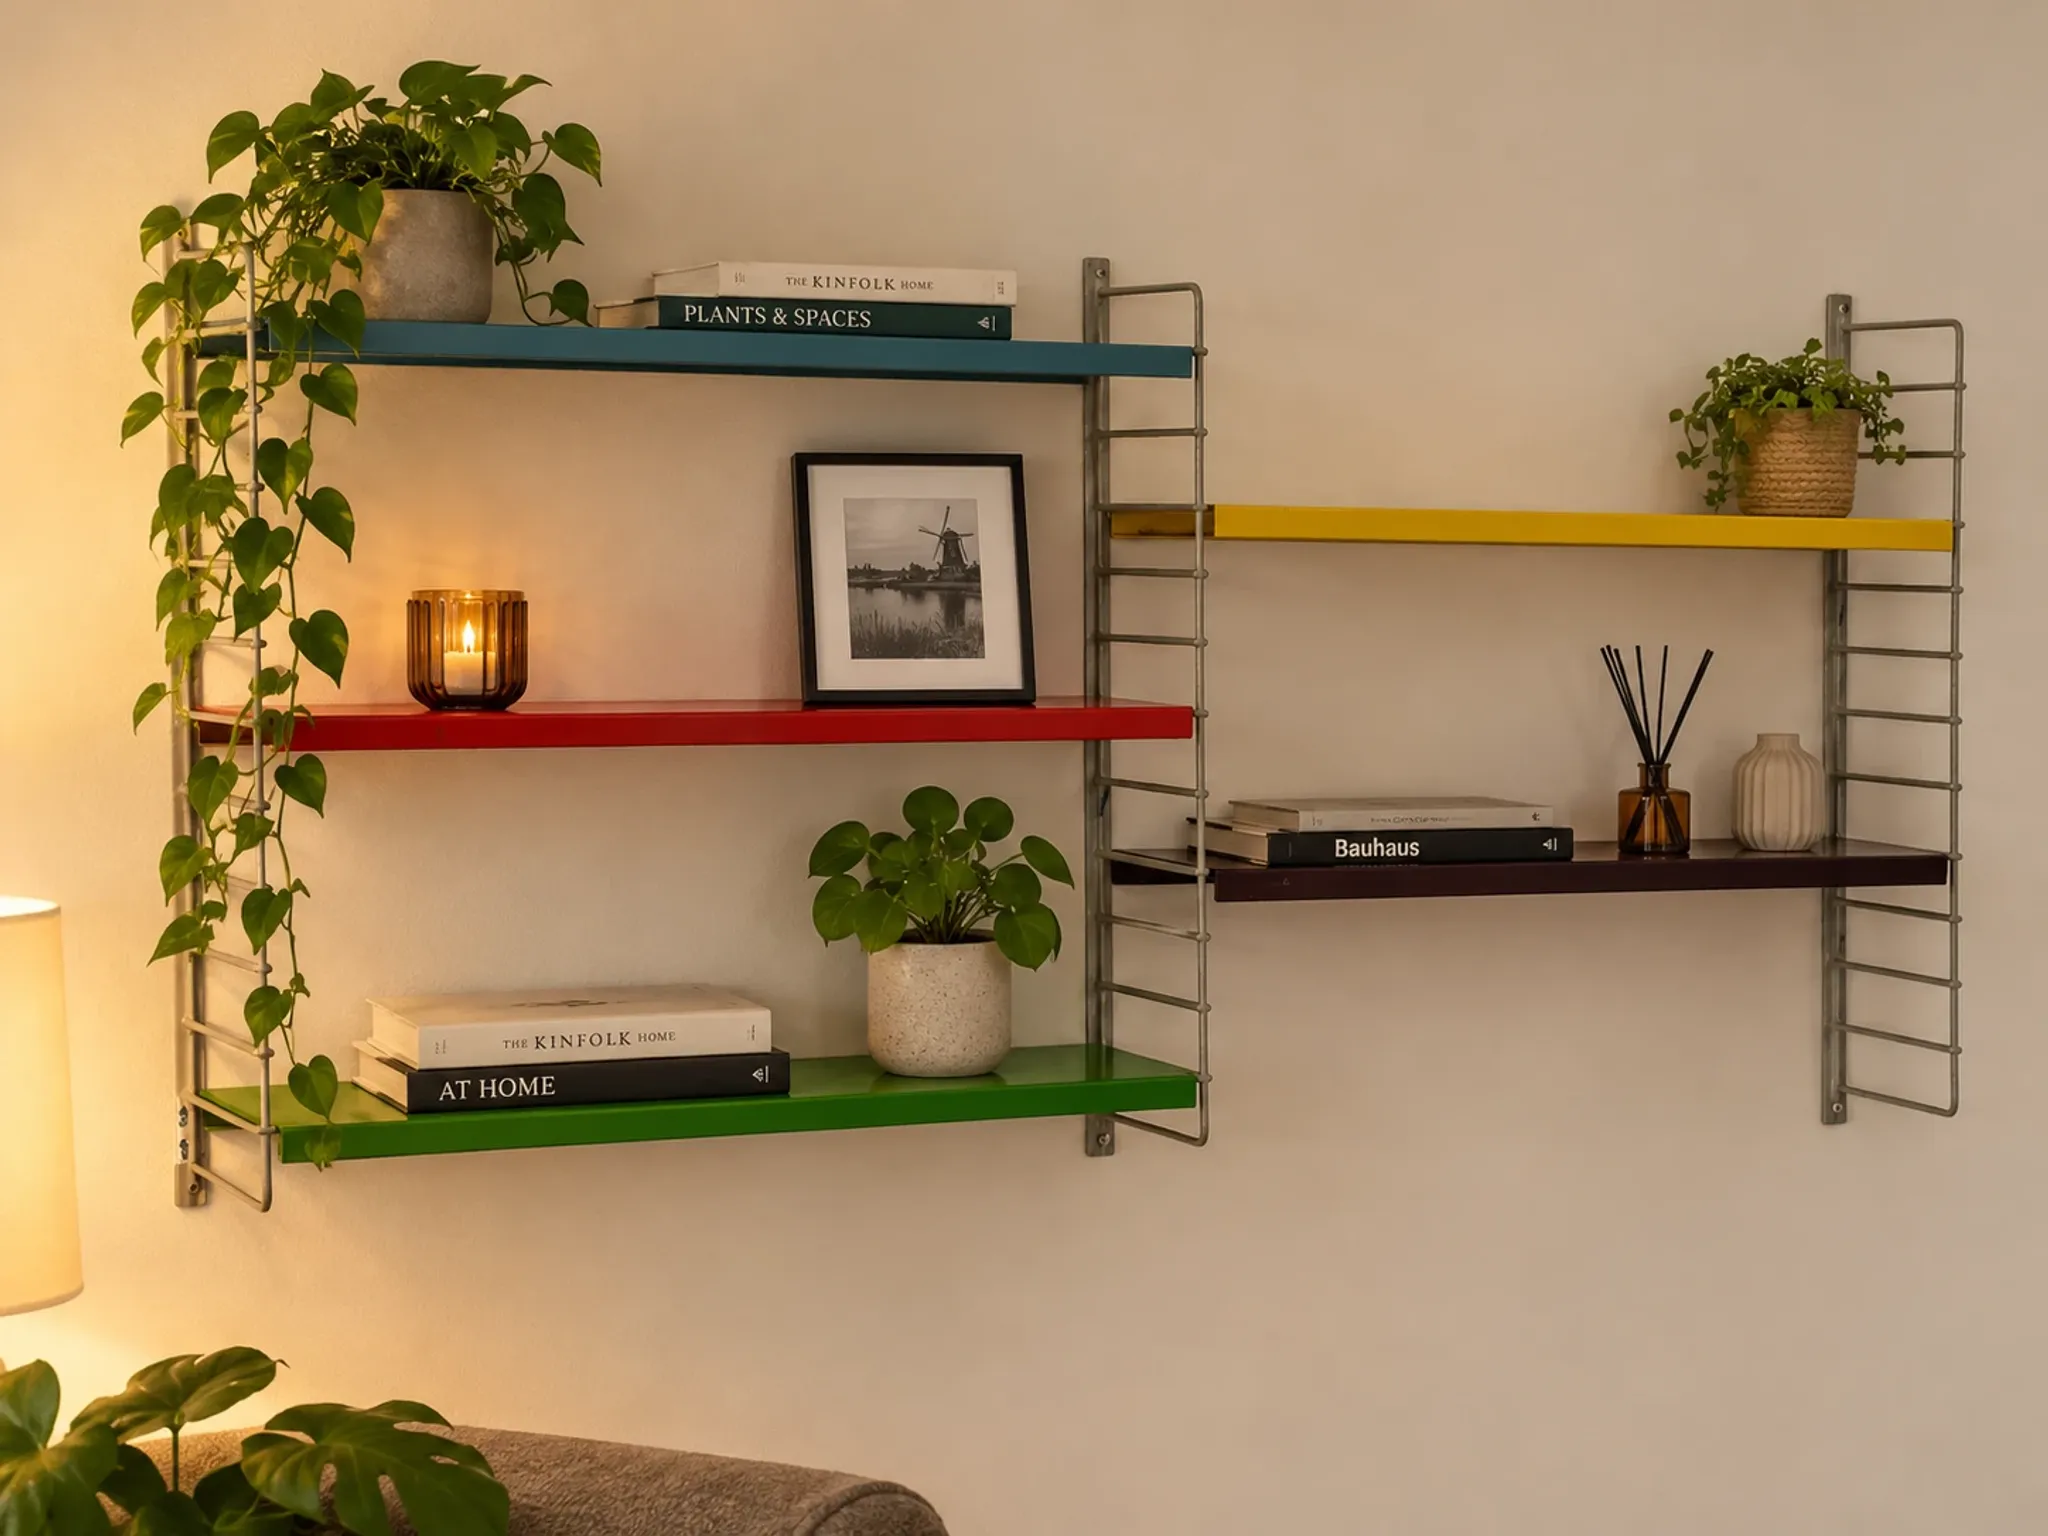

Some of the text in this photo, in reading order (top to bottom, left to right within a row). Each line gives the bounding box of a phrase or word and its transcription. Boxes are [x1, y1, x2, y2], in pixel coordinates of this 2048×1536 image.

[785, 275, 934, 291] THE KINFOLK HOME
[684, 304, 871, 329] PLANTS & SPACES
[1335, 838, 1420, 858] Bauhaus
[502, 1031, 676, 1050] THE KINFOLK HOME
[438, 1075, 555, 1101] AT HOME
